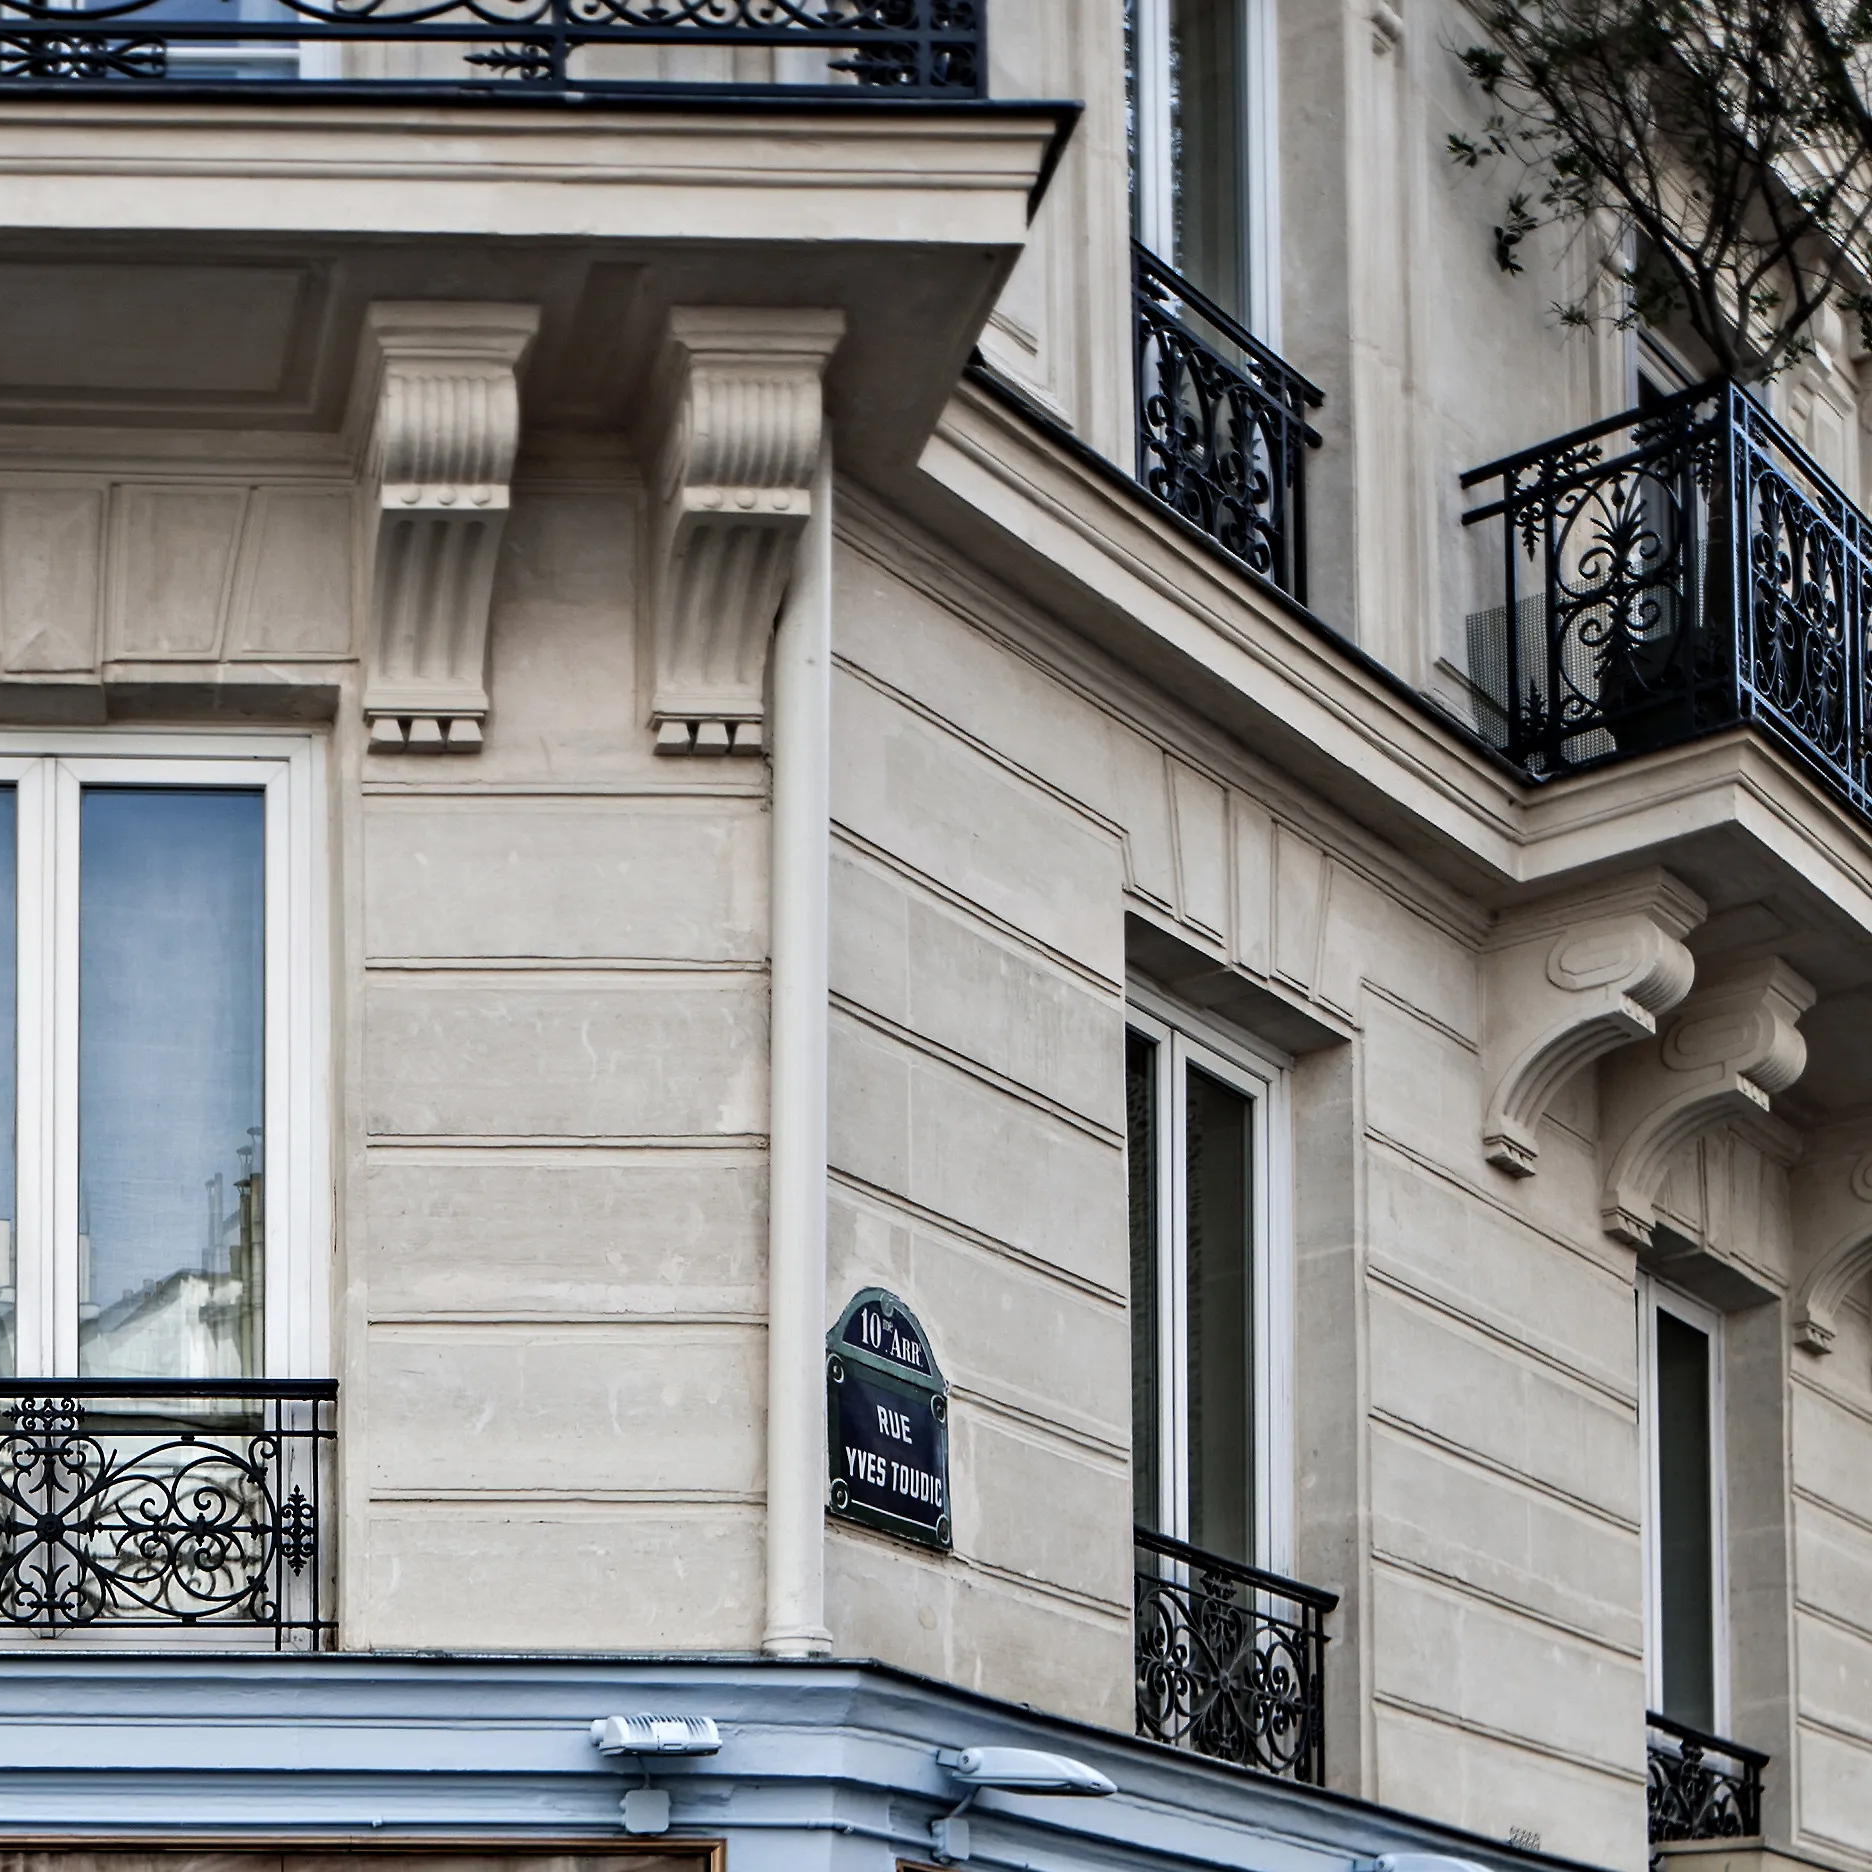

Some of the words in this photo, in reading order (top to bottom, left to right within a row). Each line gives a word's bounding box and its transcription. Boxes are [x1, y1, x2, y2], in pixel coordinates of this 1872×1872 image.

[877, 1404, 913, 1444] RUE
[845, 1445, 887, 1487] YVES
[890, 1460, 943, 1508] TOUDIC
